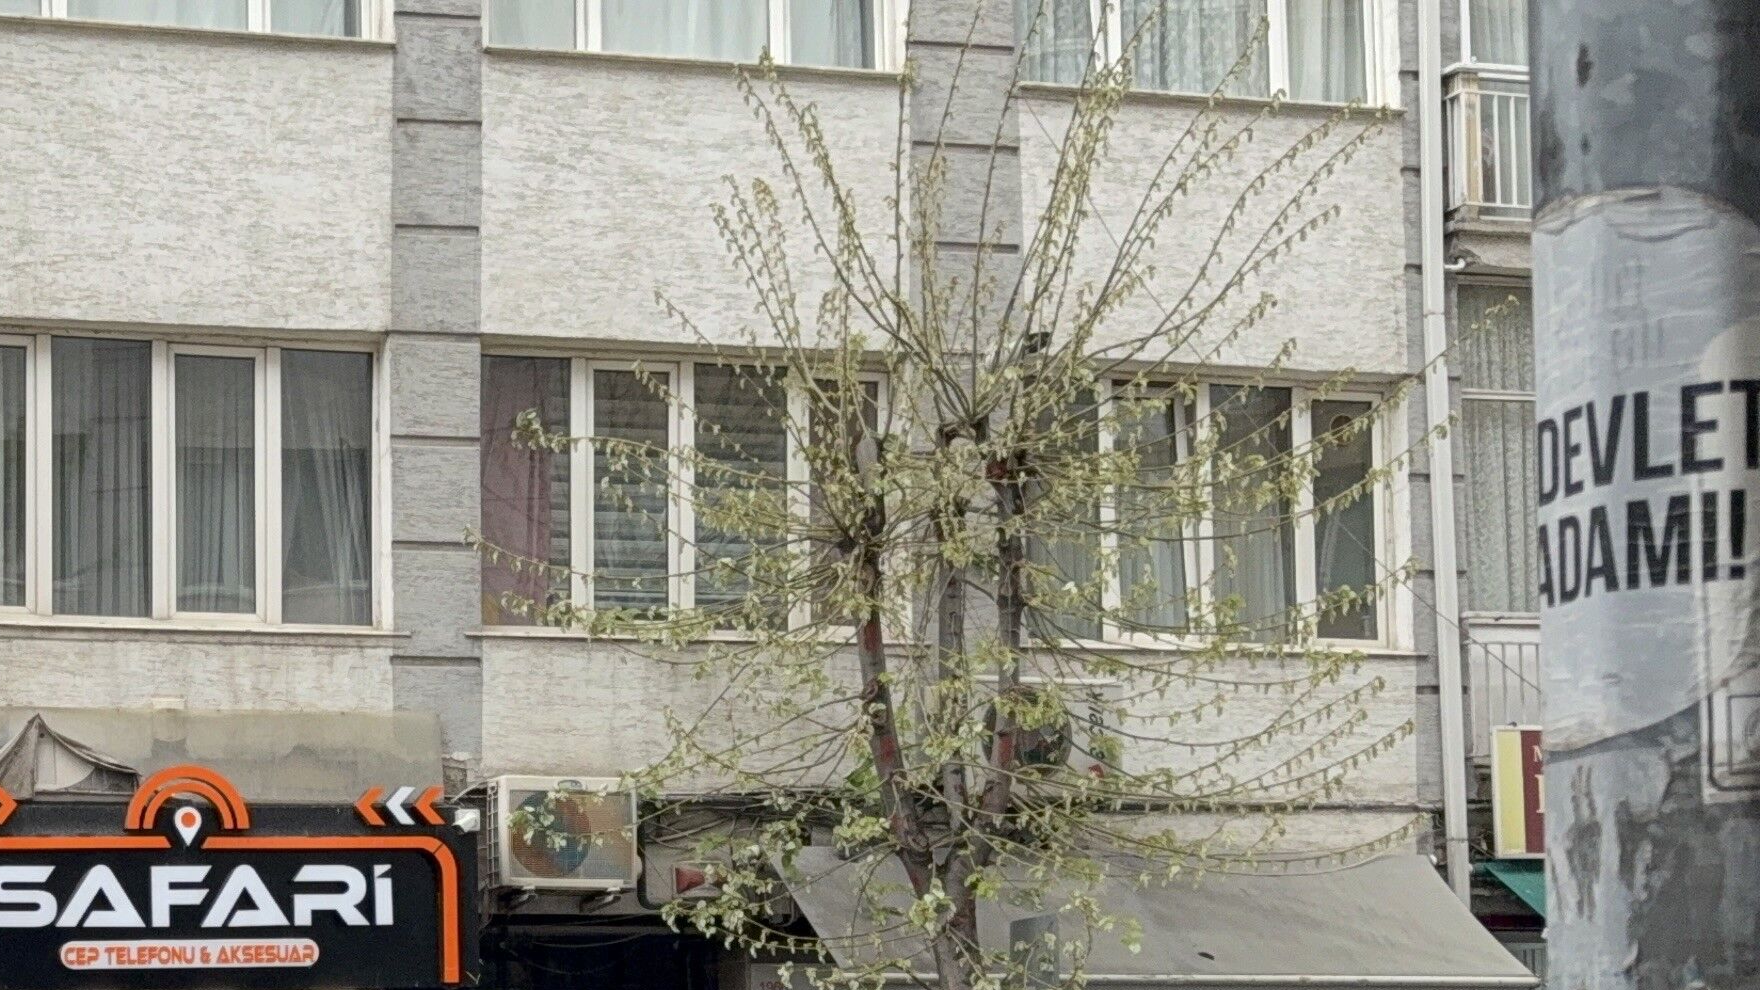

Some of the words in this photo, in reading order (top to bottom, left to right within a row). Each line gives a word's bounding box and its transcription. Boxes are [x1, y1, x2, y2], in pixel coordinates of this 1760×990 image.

[1537, 379, 1760, 507] DEVLET
[63, 947, 98, 966] CEP
[106, 946, 194, 965] TELEFONU
[200, 945, 211, 964] &
[216, 944, 316, 963] AKSESUAR
